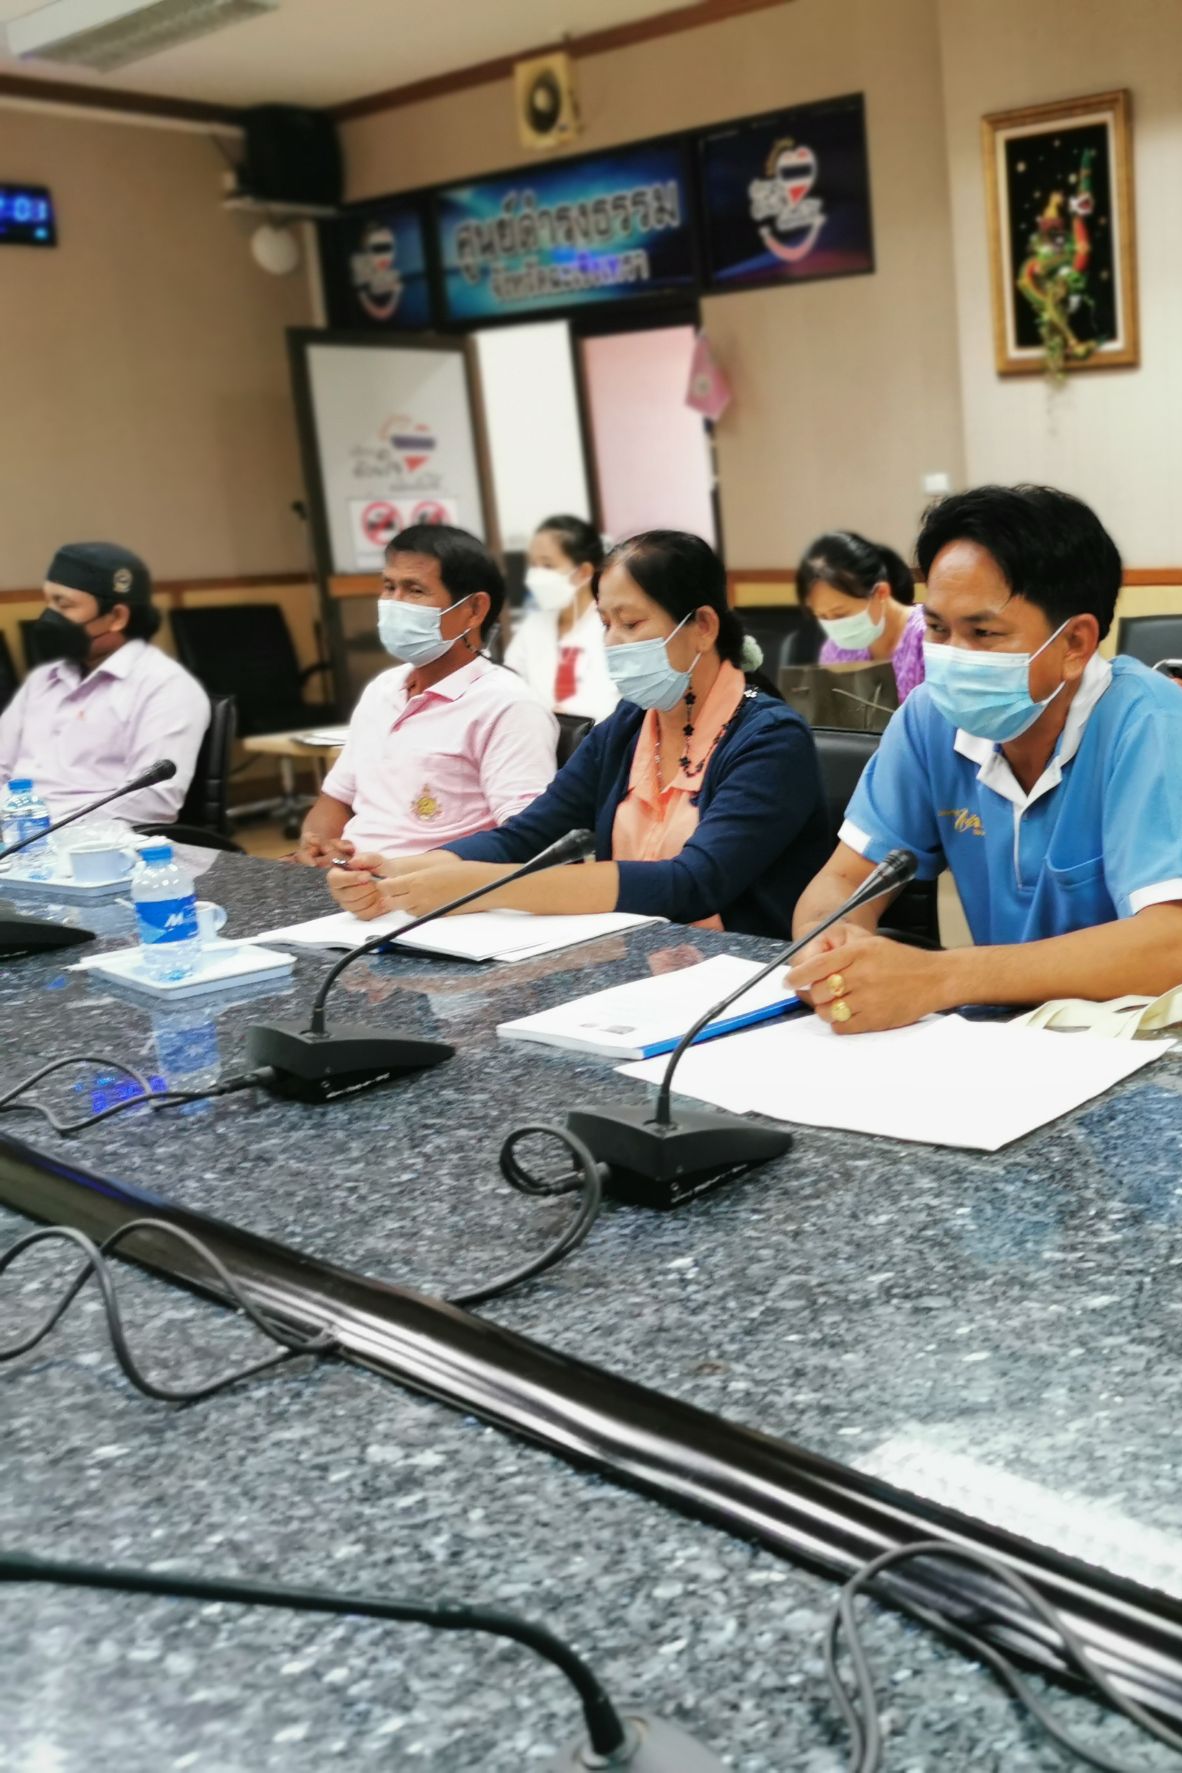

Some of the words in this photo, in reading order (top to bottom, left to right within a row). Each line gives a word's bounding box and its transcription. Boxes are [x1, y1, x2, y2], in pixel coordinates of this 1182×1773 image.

[456, 179, 681, 285] ศูนย์ดำรงธรรม
